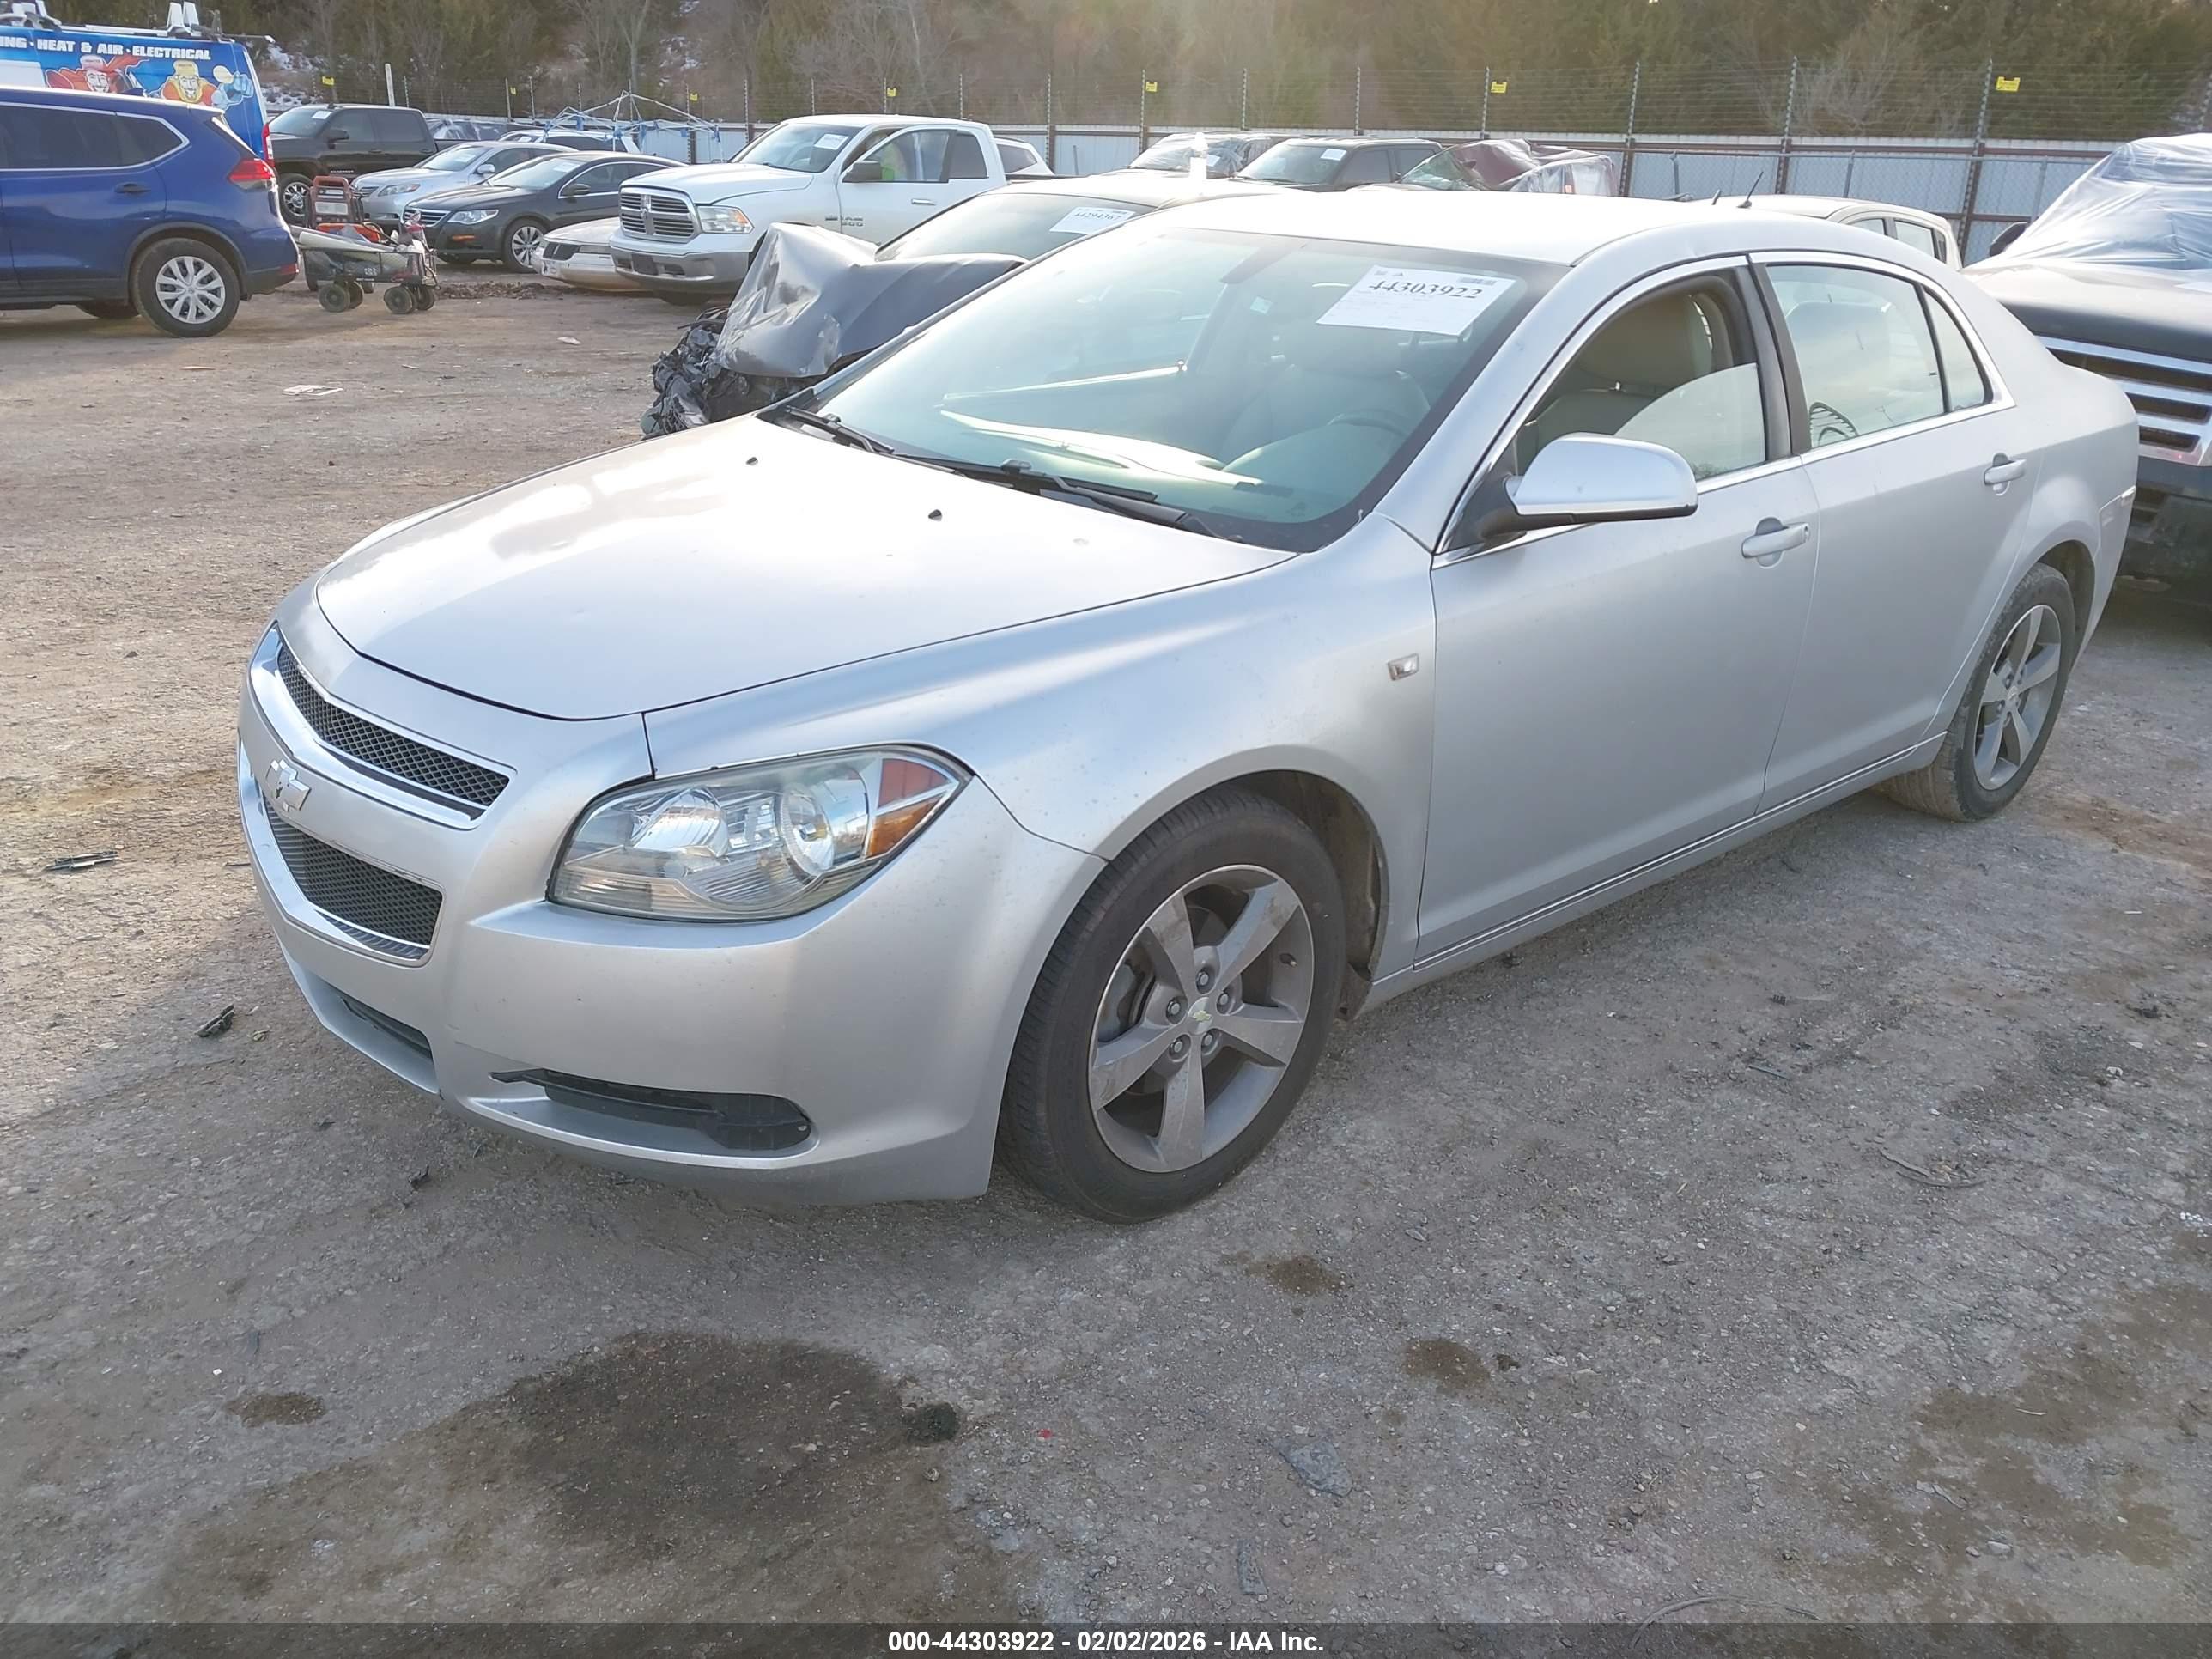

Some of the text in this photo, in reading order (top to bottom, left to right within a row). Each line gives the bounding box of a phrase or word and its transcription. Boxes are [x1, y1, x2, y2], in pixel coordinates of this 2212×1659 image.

[37, 39, 76, 52] HEAT
[81, 42, 92, 52] &
[97, 43, 124, 55] AIR
[132, 46, 211, 60] ELECTRICAL
[1369, 280, 1483, 299] 44303922
